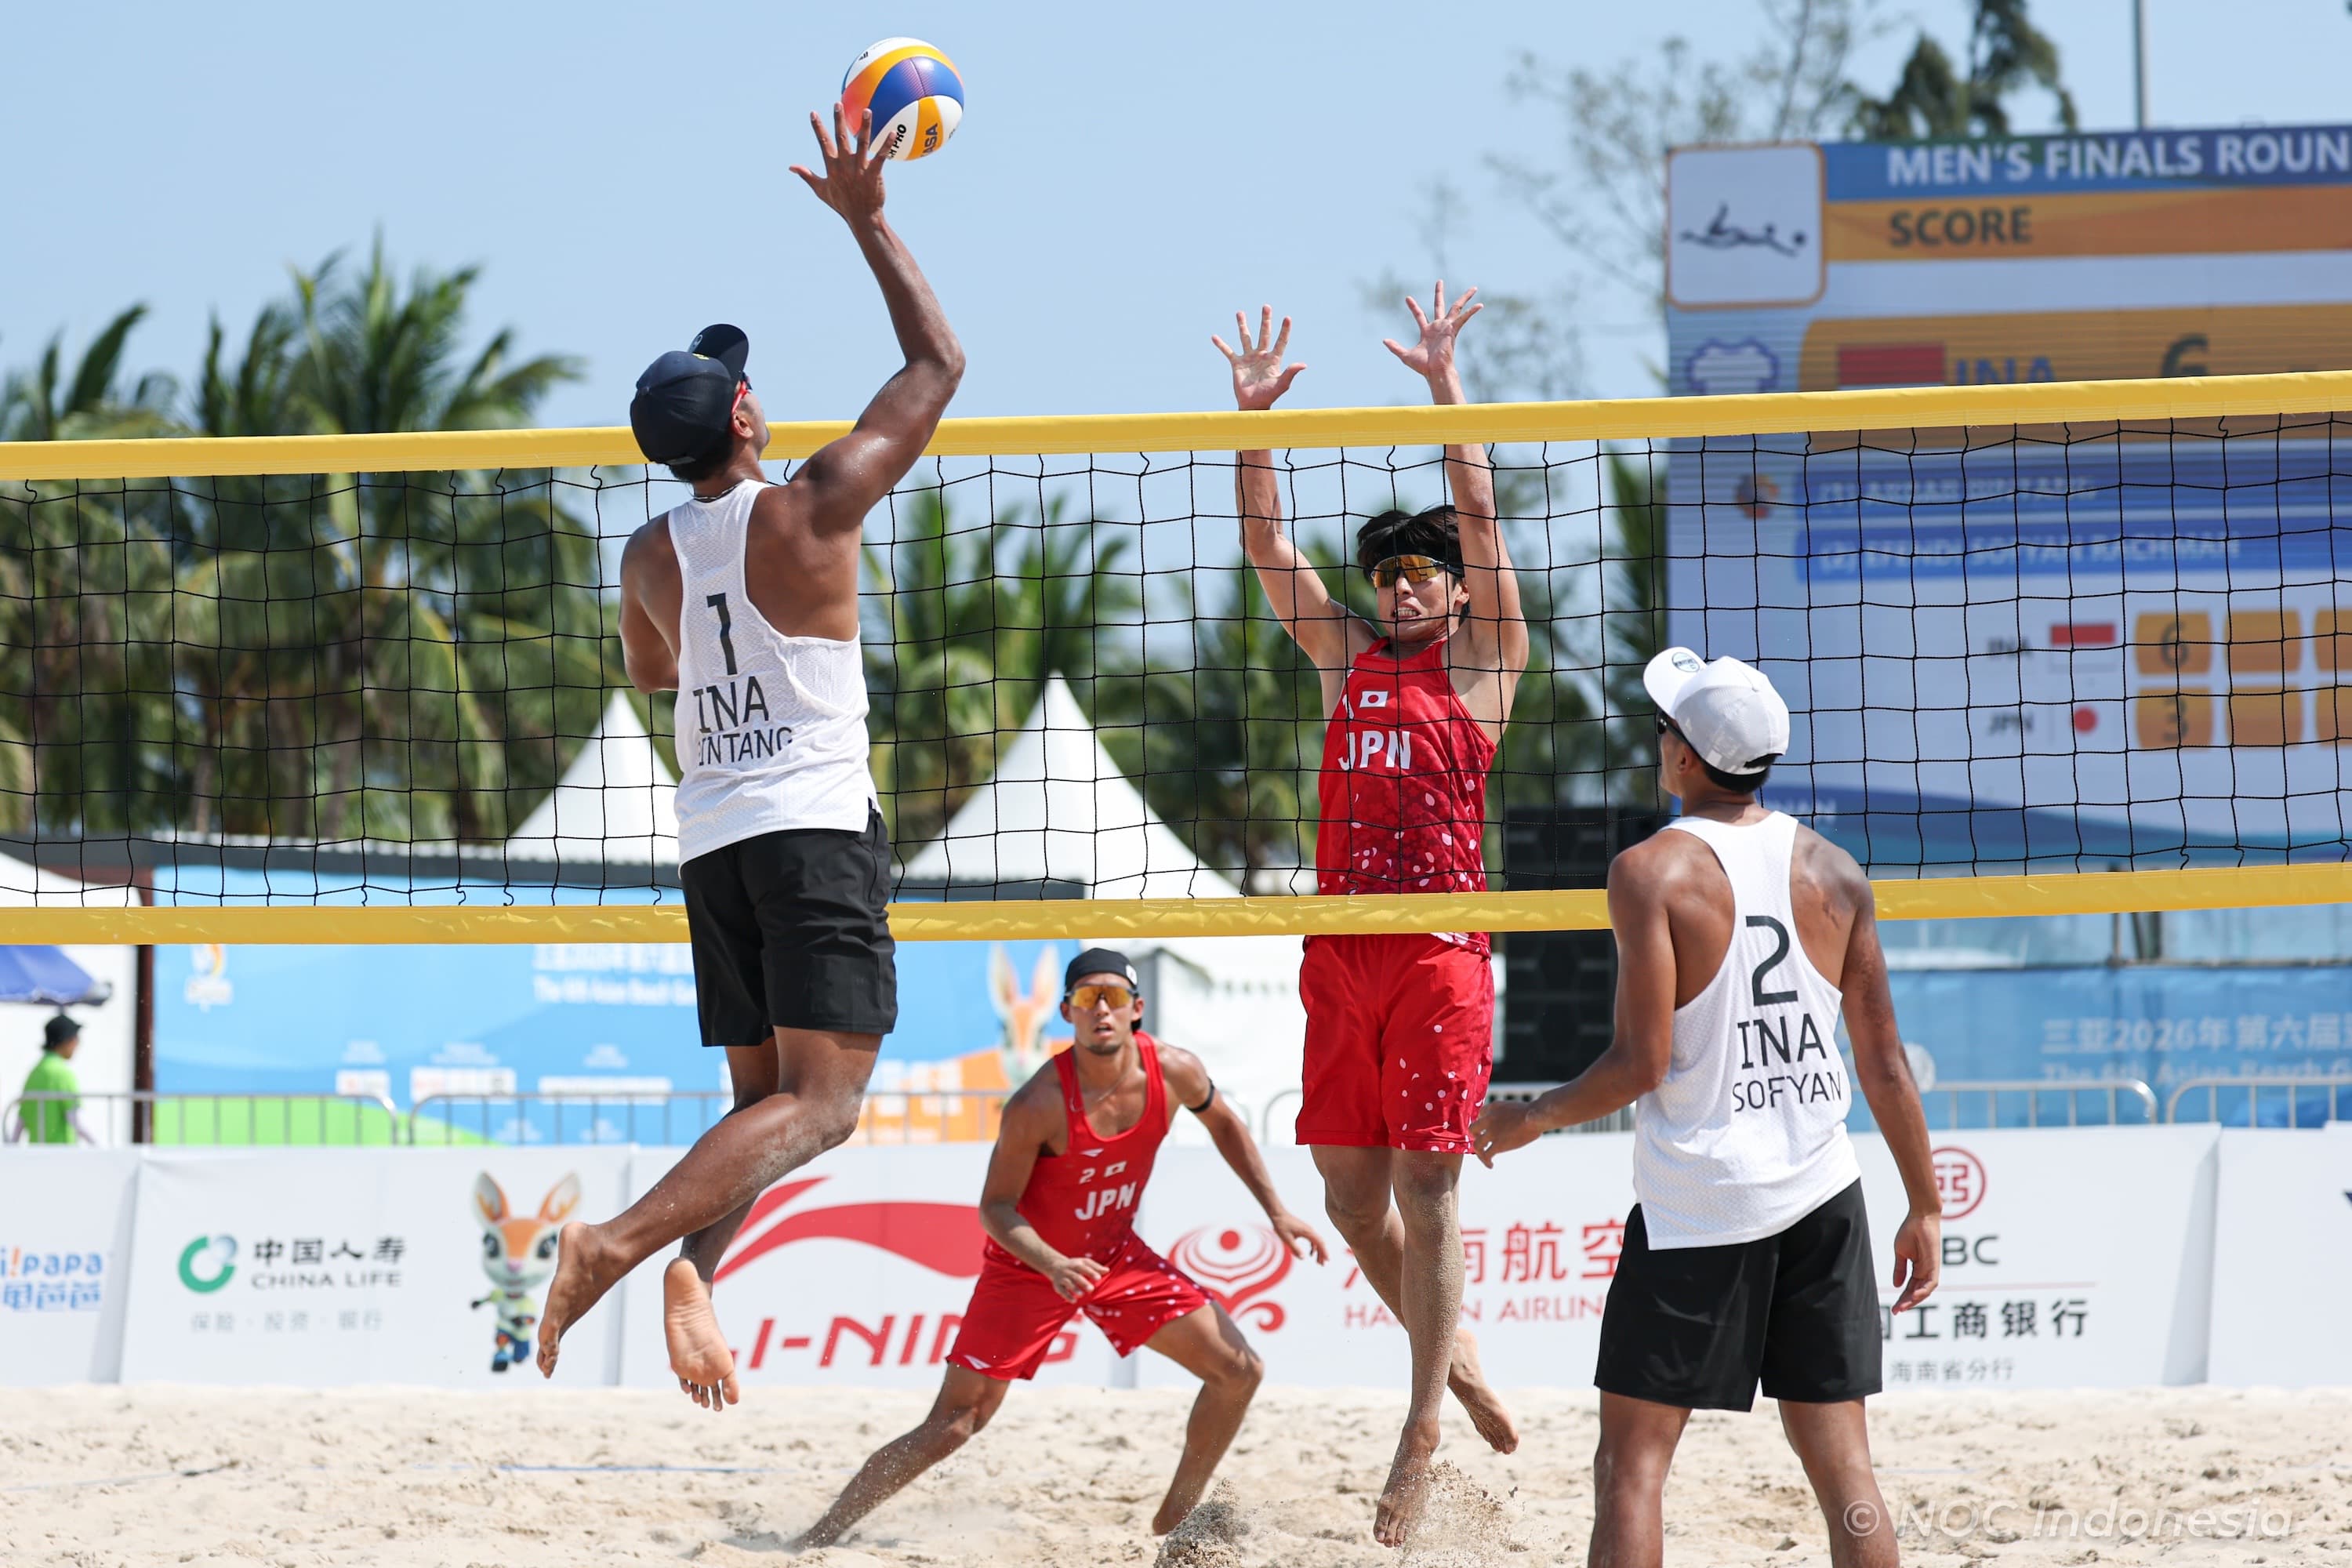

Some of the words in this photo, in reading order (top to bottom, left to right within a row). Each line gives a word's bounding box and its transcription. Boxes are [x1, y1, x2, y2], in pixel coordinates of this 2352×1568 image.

[921, 122, 938, 157] ASA
[1888, 143, 2034, 187] MEN'S
[2045, 136, 2203, 180] FINALS
[2217, 132, 2350, 176] ROUN
[1889, 206, 2033, 248] SCORE
[706, 593, 738, 675] 1
[2160, 622, 2188, 668] 6
[693, 676, 769, 734] INA
[2162, 695, 2188, 743] 3
[698, 727, 793, 766] INTANG
[1338, 730, 1411, 771] JPN
[1745, 916, 1798, 1007] 2
[1737, 1013, 1828, 1070] INA
[2042, 1013, 2352, 1054] 三亚2026年第六届
[1731, 1071, 1842, 1112] SOFYAN
[1079, 1167, 1096, 1185] 2
[1074, 1181, 1138, 1221] JPN
[254, 1235, 407, 1266] 中国人寿
[1344, 1218, 1627, 1290] 航空
[1942, 1235, 2001, 1266] BC
[250, 1272, 334, 1289] CHINA
[344, 1270, 403, 1288] LIFE
[1344, 1299, 1483, 1327] HAN
[1498, 1294, 1606, 1323] AIRLIN
